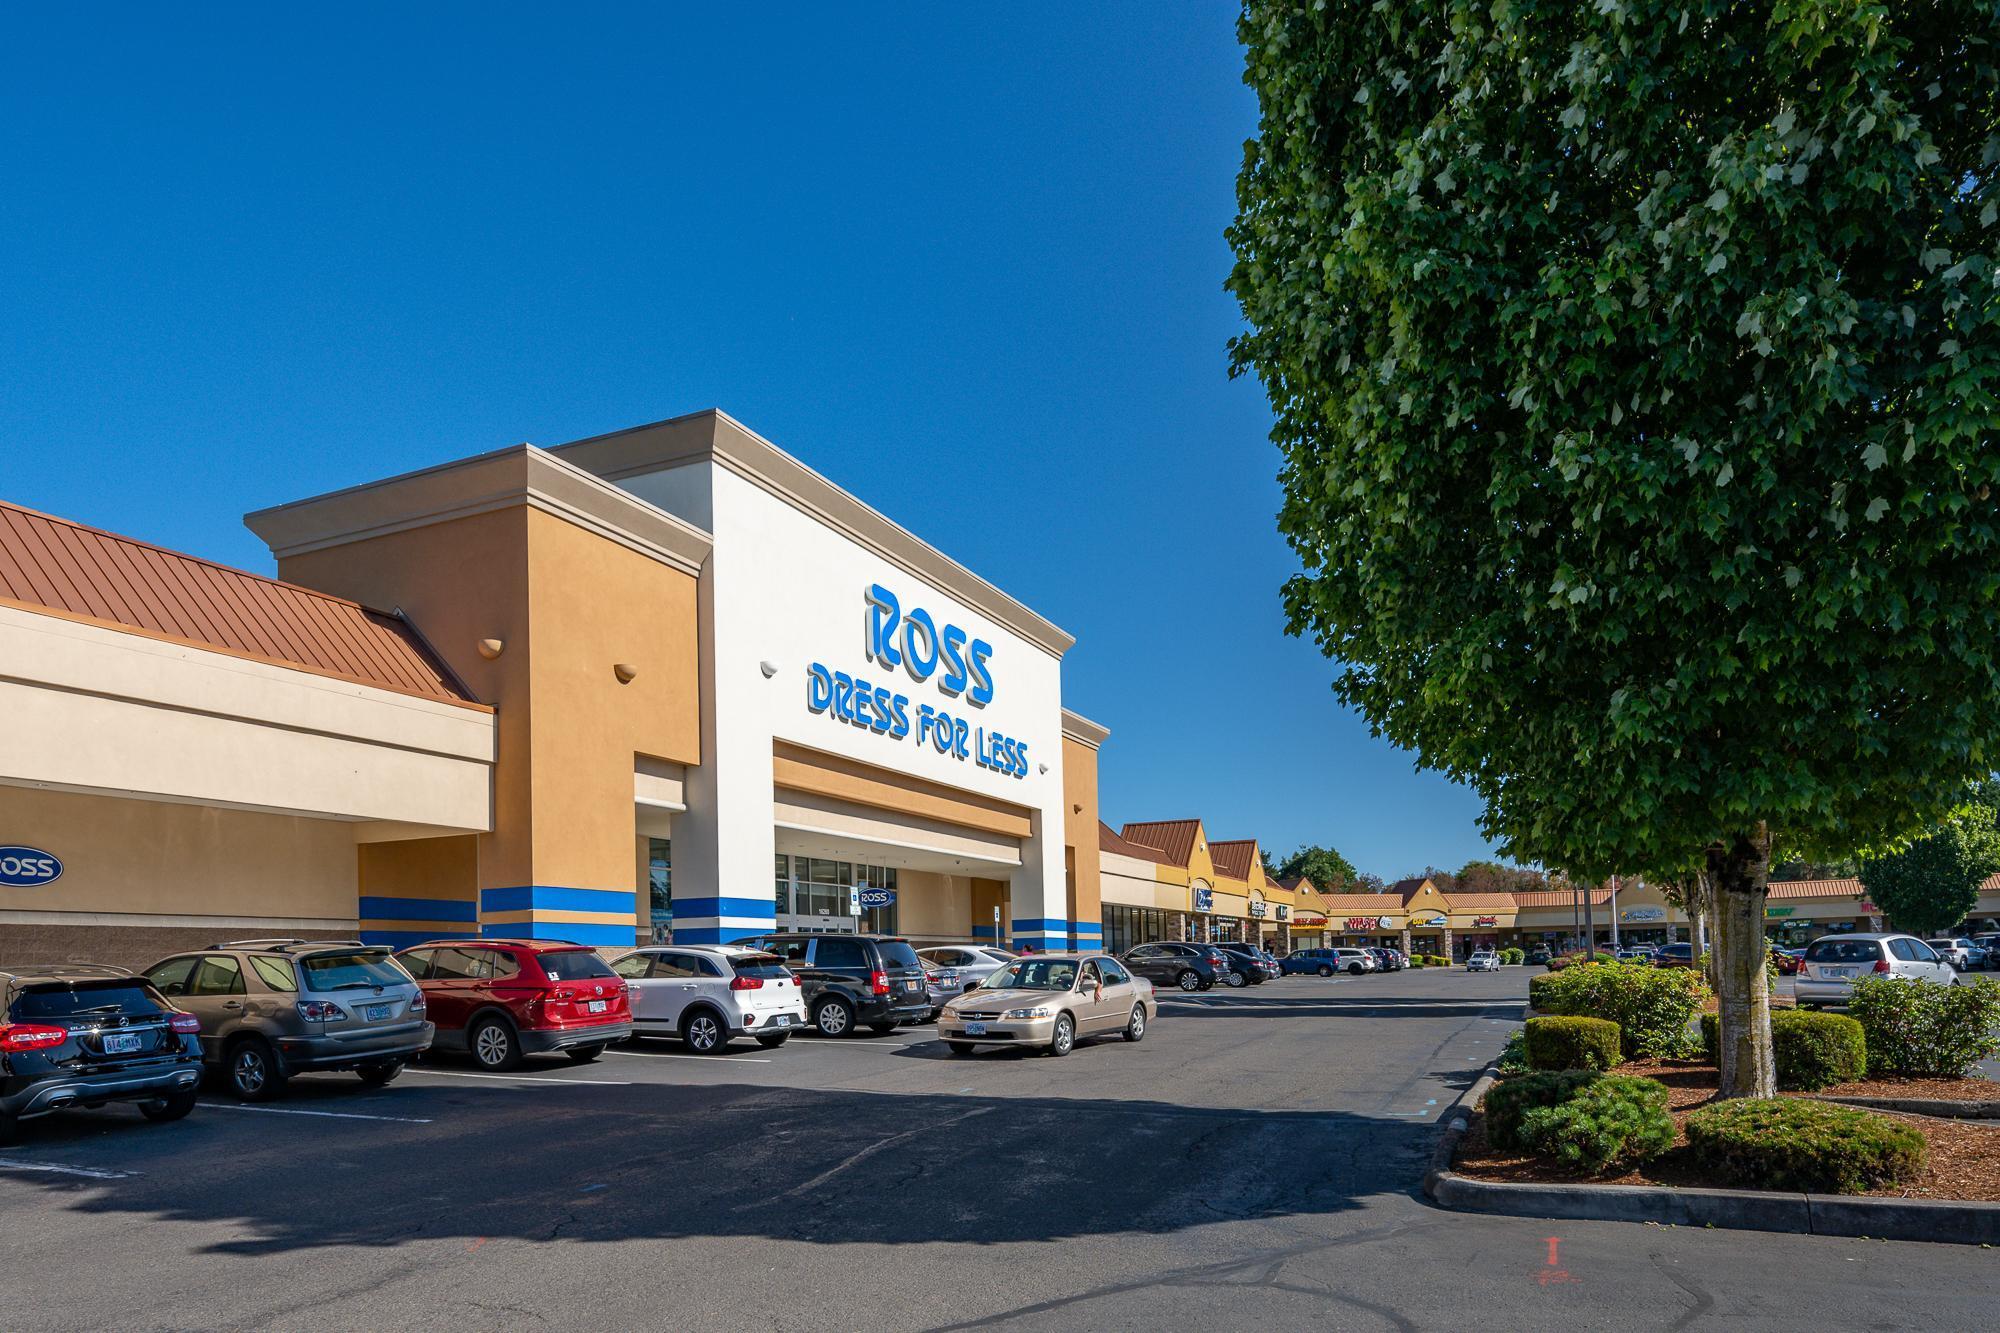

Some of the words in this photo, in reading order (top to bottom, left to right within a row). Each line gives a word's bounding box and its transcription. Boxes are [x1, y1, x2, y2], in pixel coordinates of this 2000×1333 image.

[865, 583, 994, 709] ROSS
[807, 662, 910, 740] DRESS
[916, 703, 969, 761] FOR
[975, 726, 1028, 779] LESS
[0, 856, 54, 877] OSS
[861, 892, 887, 903] ROSS
